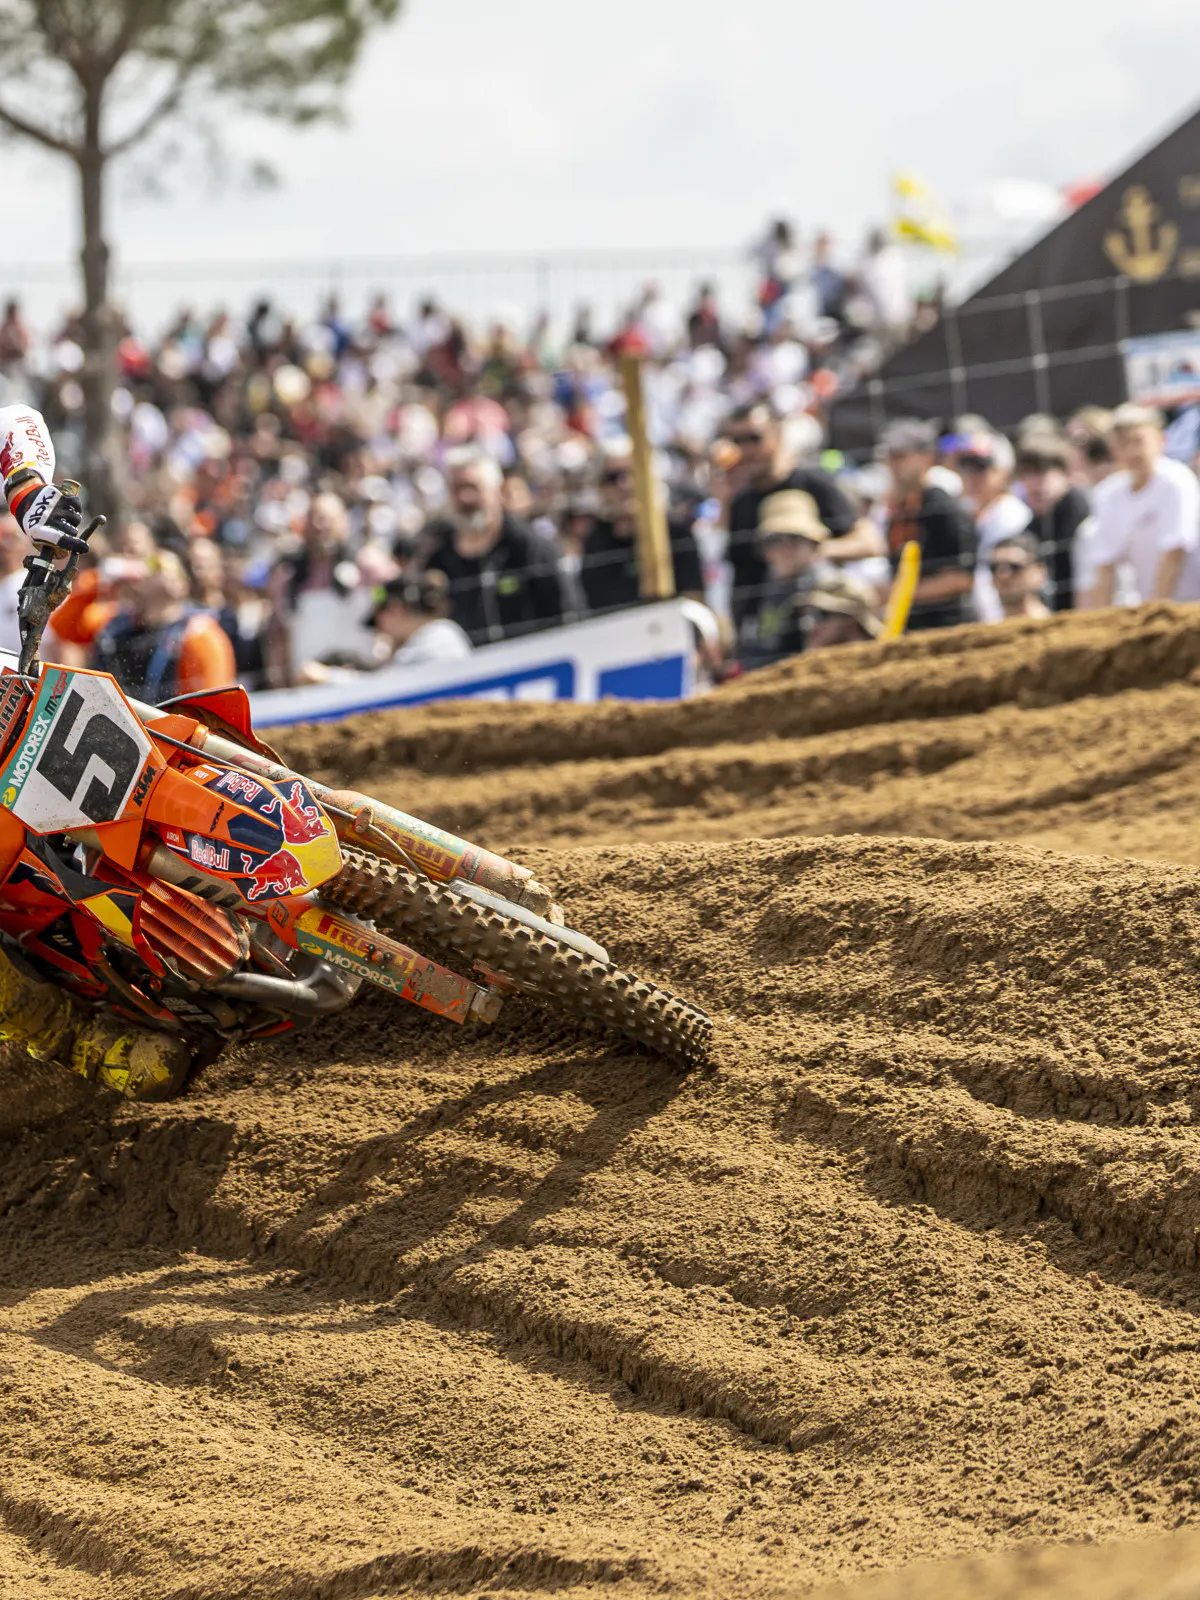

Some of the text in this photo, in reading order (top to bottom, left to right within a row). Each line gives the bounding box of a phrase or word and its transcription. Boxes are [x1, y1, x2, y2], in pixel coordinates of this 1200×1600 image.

[9, 713, 51, 788] MOTOREX
[36, 688, 141, 824] 5
[132, 765, 157, 808] KTM
[323, 949, 400, 992] MOTOREX
